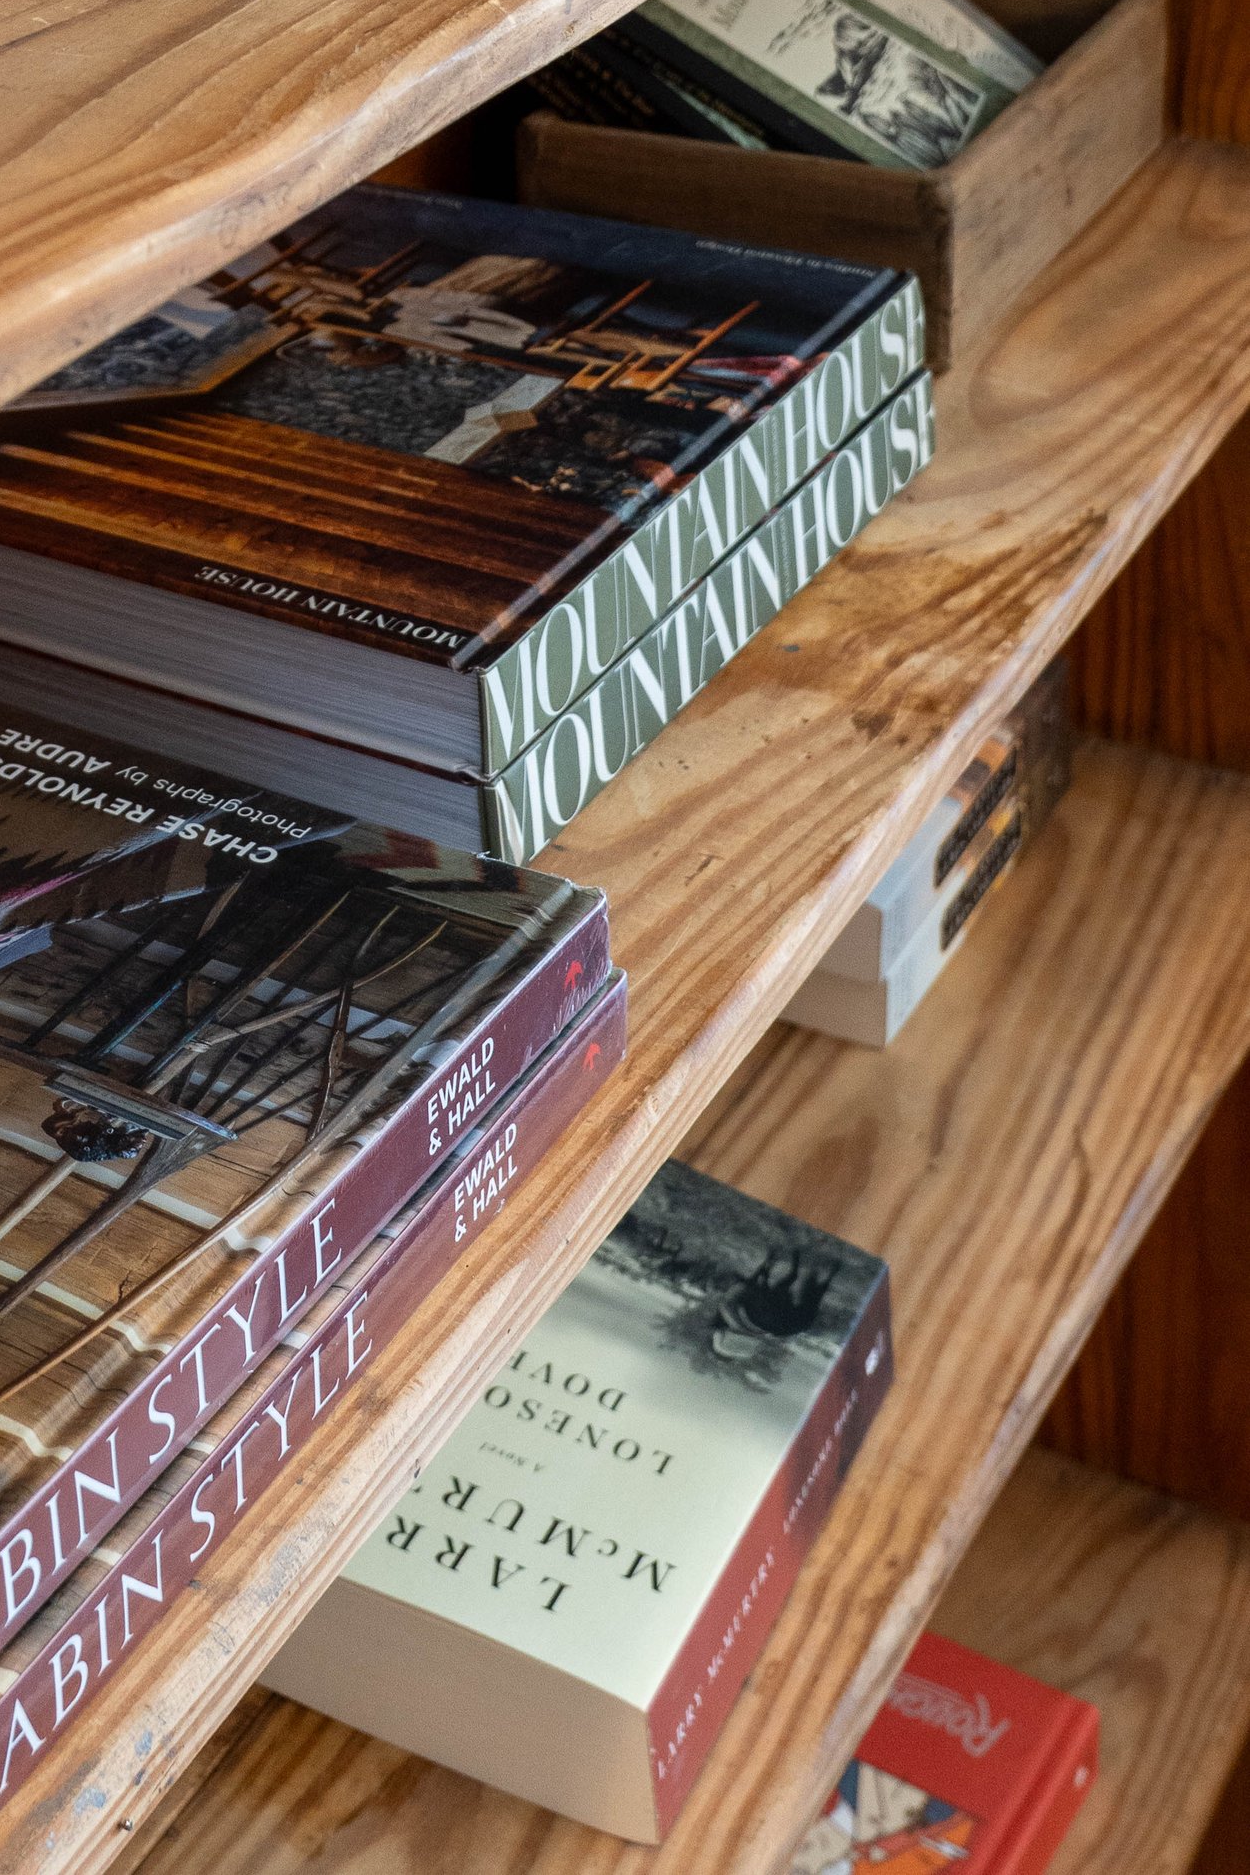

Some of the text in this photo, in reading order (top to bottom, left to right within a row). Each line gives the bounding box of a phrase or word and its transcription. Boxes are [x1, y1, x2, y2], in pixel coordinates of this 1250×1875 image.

[483, 281, 925, 780] MOUNTAIN HOUSE
[194, 565, 467, 649] MOUNTAIN HOUSE
[490, 535, 787, 866] MOUNTAIN
[791, 370, 935, 599] HOUSE
[115, 766, 149, 786] by
[152, 777, 312, 841] Photographs
[156, 814, 278, 865] CHASE
[427, 1036, 495, 1124] EWALD
[428, 1070, 496, 1156] & HALL
[454, 1122, 517, 1213] EWALD
[454, 1155, 518, 1243] & HALL
[149, 1199, 343, 1462] STYLE
[188, 1290, 374, 1564] STYLE
[479, 1441, 545, 1473] A Novel
[483, 1384, 674, 1476] LONESO
[386, 1514, 572, 1613] LARR
[410, 1475, 677, 1594] McMUR
[656, 1684, 704, 1780] LARRY
[706, 1546, 775, 1683] McMURTRY
